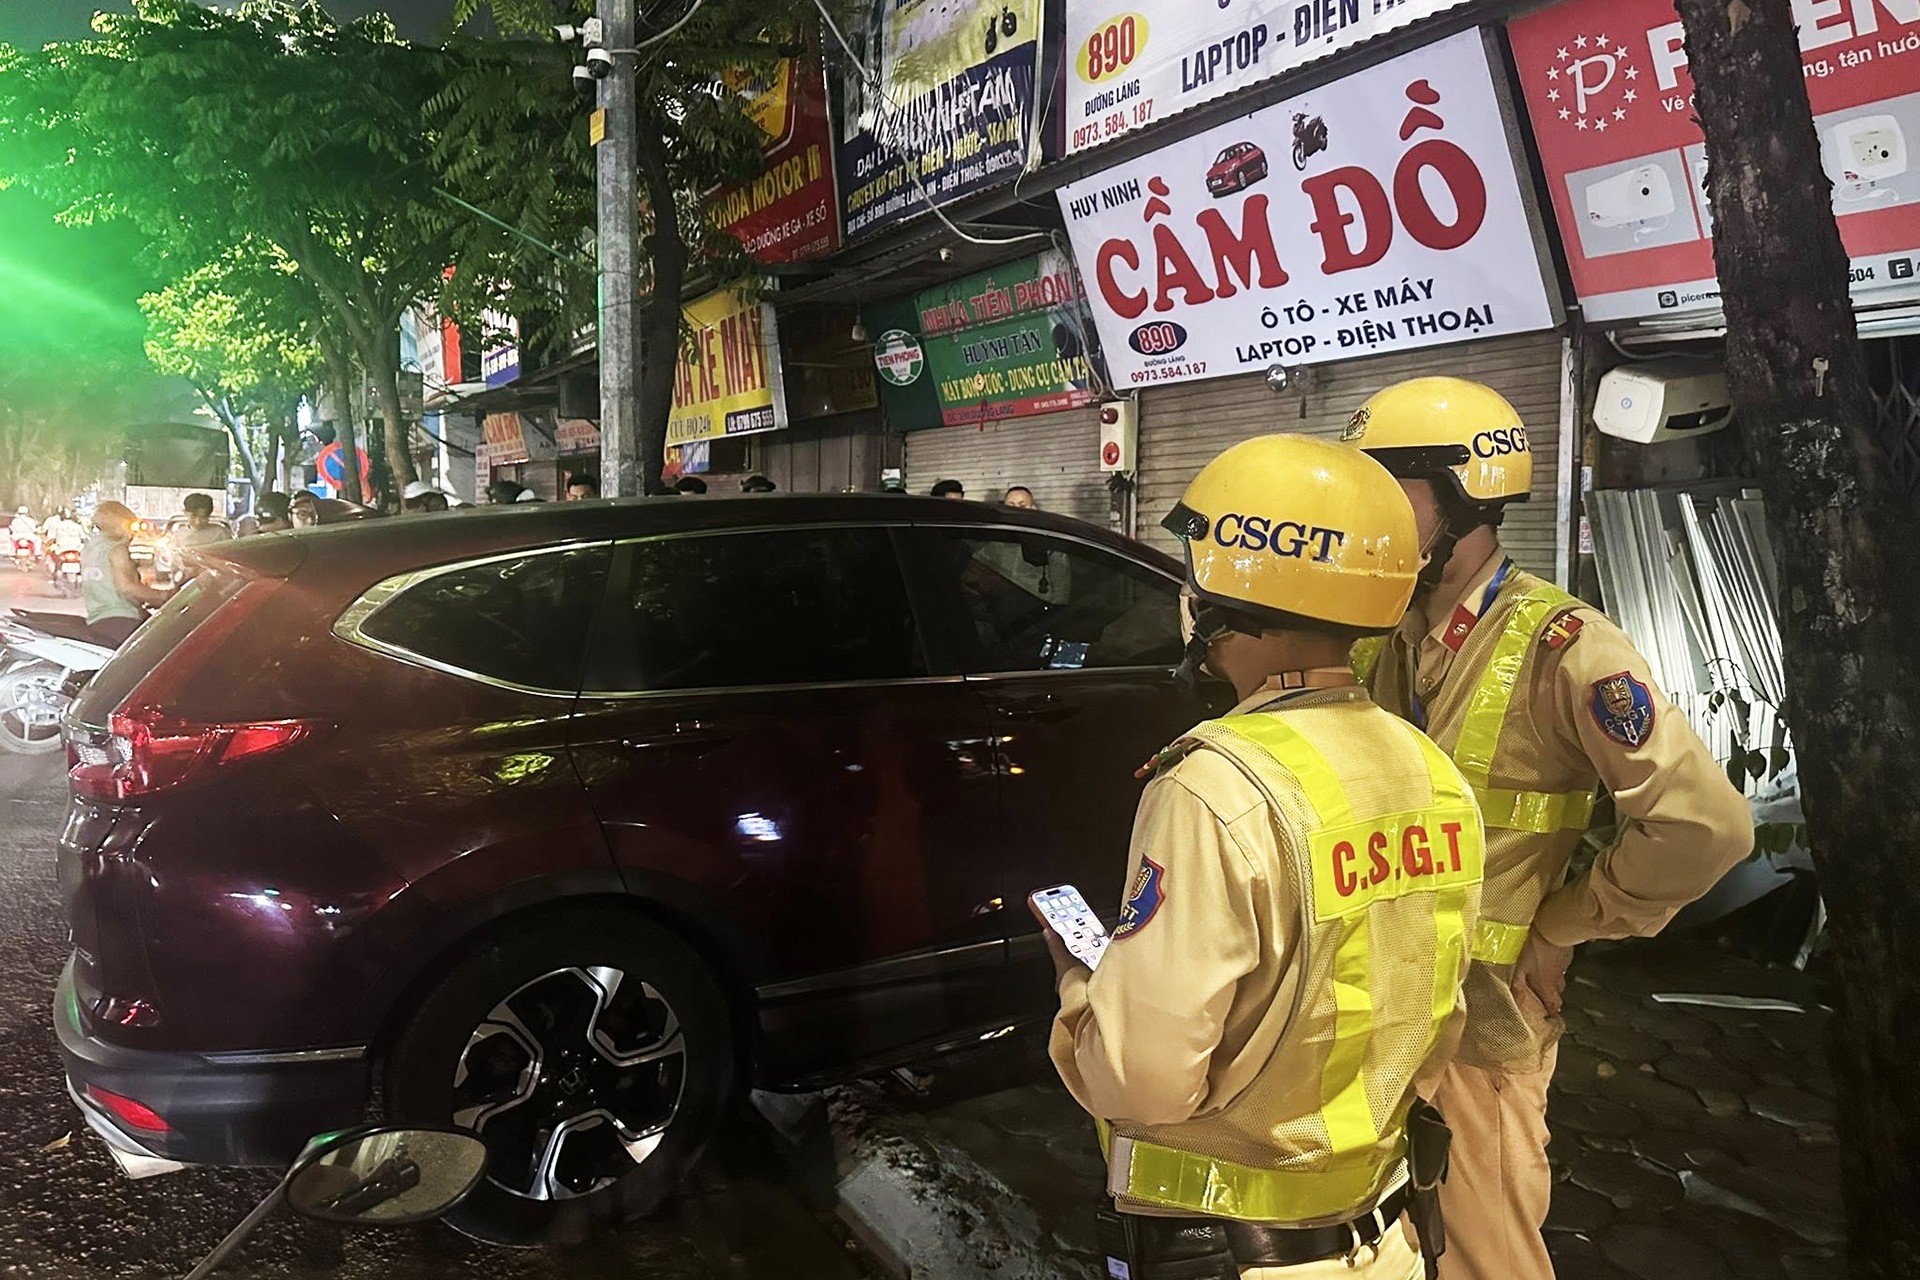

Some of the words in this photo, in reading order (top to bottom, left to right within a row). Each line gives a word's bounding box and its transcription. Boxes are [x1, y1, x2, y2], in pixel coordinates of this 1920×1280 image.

[1088, 16, 1136, 81] 890
[1181, 23, 1268, 93] LAPTOP
[1085, 89, 1114, 117] ĐƯỜNG
[1116, 79, 1141, 104] LÁNG
[1662, 95, 1685, 113] Vẻ
[1838, 46, 1873, 69] tận
[1073, 121, 1102, 149] 0973.
[1104, 111, 1129, 137] 584.
[1132, 98, 1155, 125] 187
[752, 155, 804, 212] MOTOR
[1070, 193, 1098, 220] HUY
[1102, 178, 1142, 209] NINH
[1096, 176, 1290, 319] CẦM
[1302, 79, 1487, 275] ĐỒ
[1261, 305, 1279, 330] Ô
[1283, 299, 1315, 325] TÔ
[1335, 292, 1368, 317] XE
[1373, 276, 1435, 309] MÁY
[1137, 323, 1177, 354] 890
[1235, 334, 1317, 364] LAPTOP
[1337, 319, 1397, 349] ĐIỆN
[1402, 304, 1494, 337] THOẠI
[693, 325, 720, 404] XE
[1007, 366, 1035, 396] DỤNG
[1035, 362, 1051, 391] CỤ
[1131, 362, 1208, 384] 0973.584.187
[1213, 513, 1345, 564] CSGT
[1331, 822, 1463, 898] C.S.G.T
